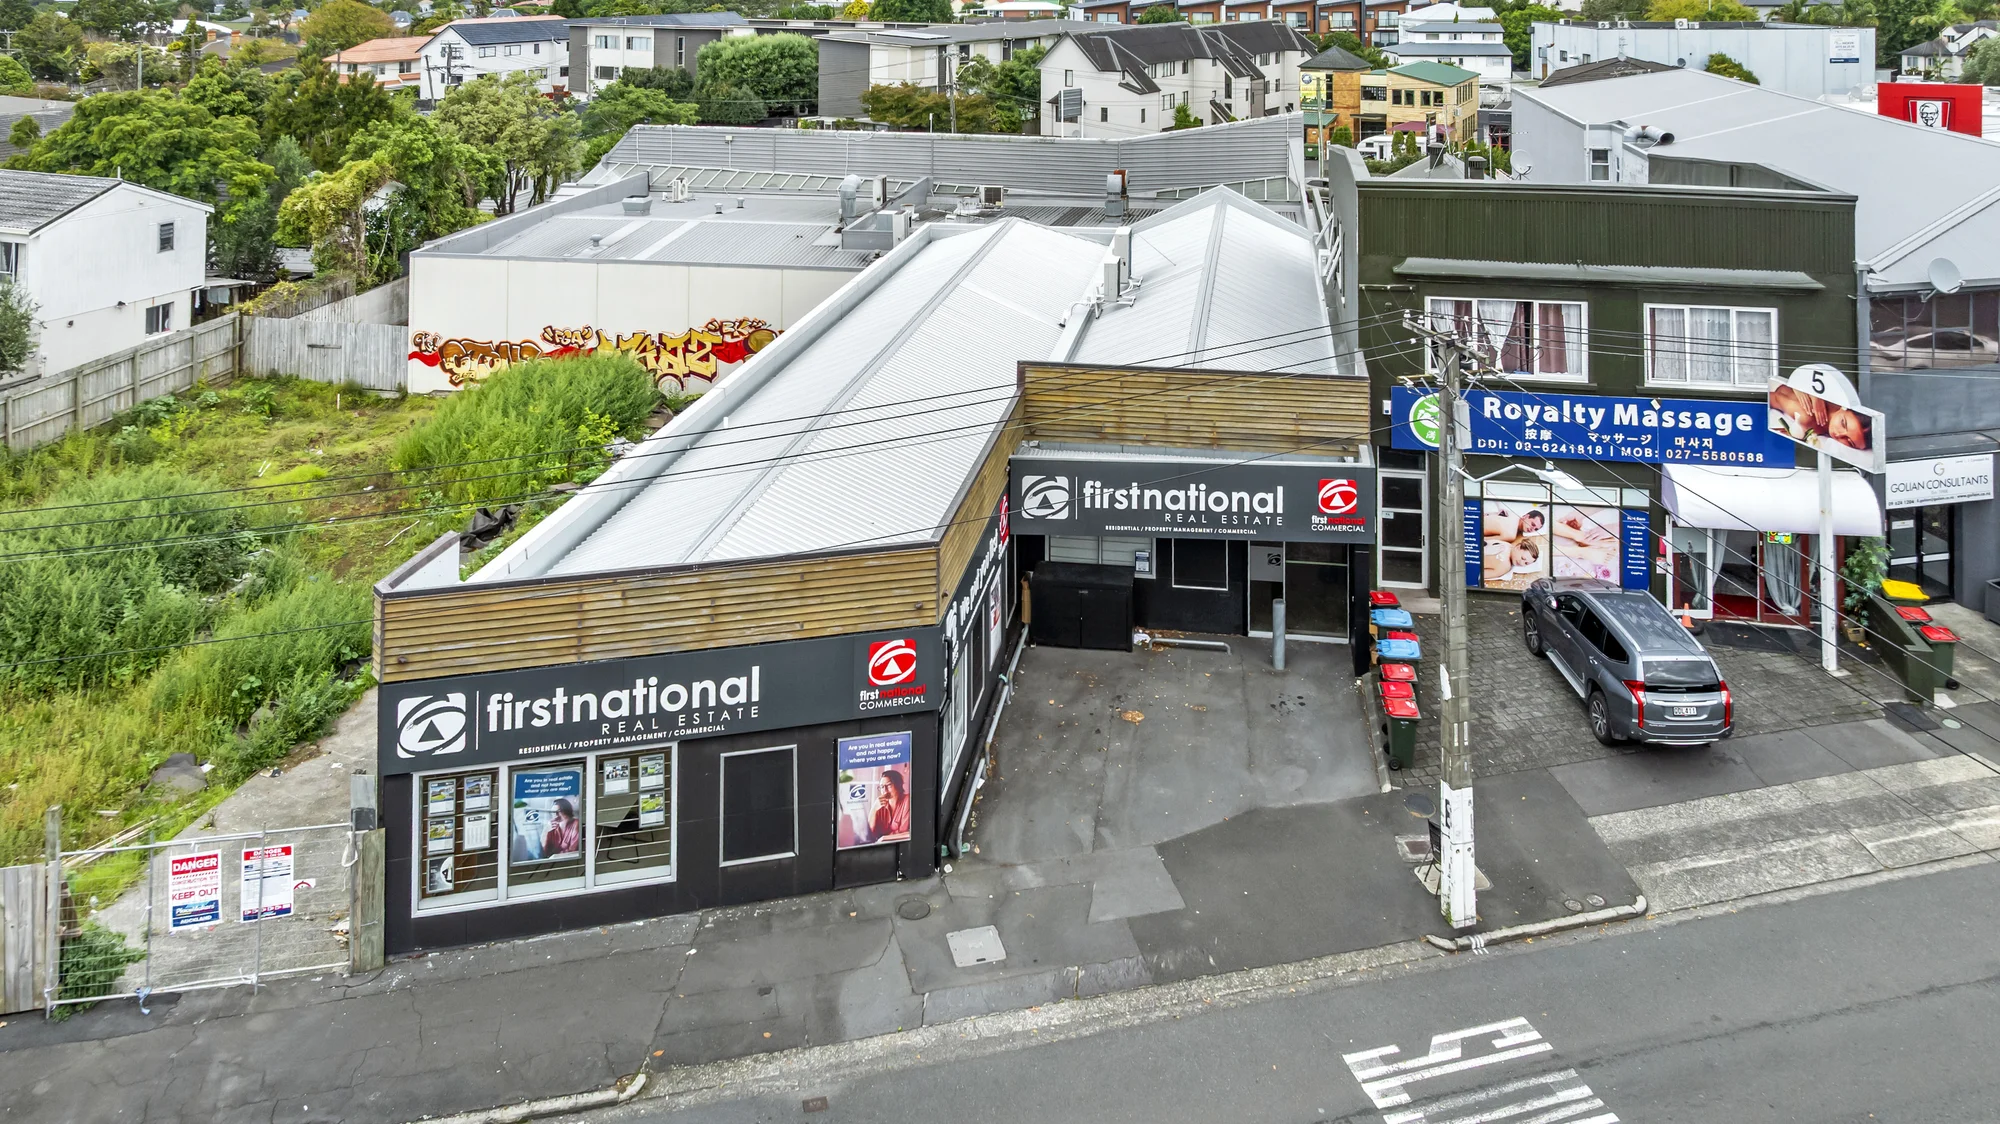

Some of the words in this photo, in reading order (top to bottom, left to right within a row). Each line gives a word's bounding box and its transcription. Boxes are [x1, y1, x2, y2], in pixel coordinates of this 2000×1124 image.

[1812, 370, 1825, 394] 5
[1483, 396, 1606, 430] Royalty
[1613, 403, 1753, 436] Massage
[1524, 428, 1552, 441] 按摩
[1587, 432, 1652, 445] マッサージ
[1477, 438, 1509, 449] DDI:
[1621, 447, 1659, 458] MOB:
[1666, 449, 1763, 462] 027-5580588
[1674, 437, 1713, 449] 마사지
[1890, 482, 1924, 493] GOLIAN
[1926, 475, 1989, 490] CONSULTANTS
[1083, 480, 1284, 513] firstnational
[1164, 513, 1207, 523] REAL
[1221, 514, 1283, 526] ESTATE
[1311, 524, 1365, 532] COMMERCIAL
[487, 665, 760, 732] firstnational
[859, 695, 926, 710] COMMERCIAL
[602, 718, 658, 735] REAL
[678, 706, 759, 726] ESTATE
[518, 743, 567, 755] RESIDENTIAL
[573, 737, 611, 748] PROPERTY
[612, 731, 667, 744] MANAGEMENT
[673, 724, 725, 736] COMMERCIAL
[877, 747, 894, 755] happy
[173, 857, 217, 871] DANGER
[172, 890, 195, 900] KEEP
[198, 887, 219, 897] OUT
[180, 915, 212, 924] AUCKLAND
